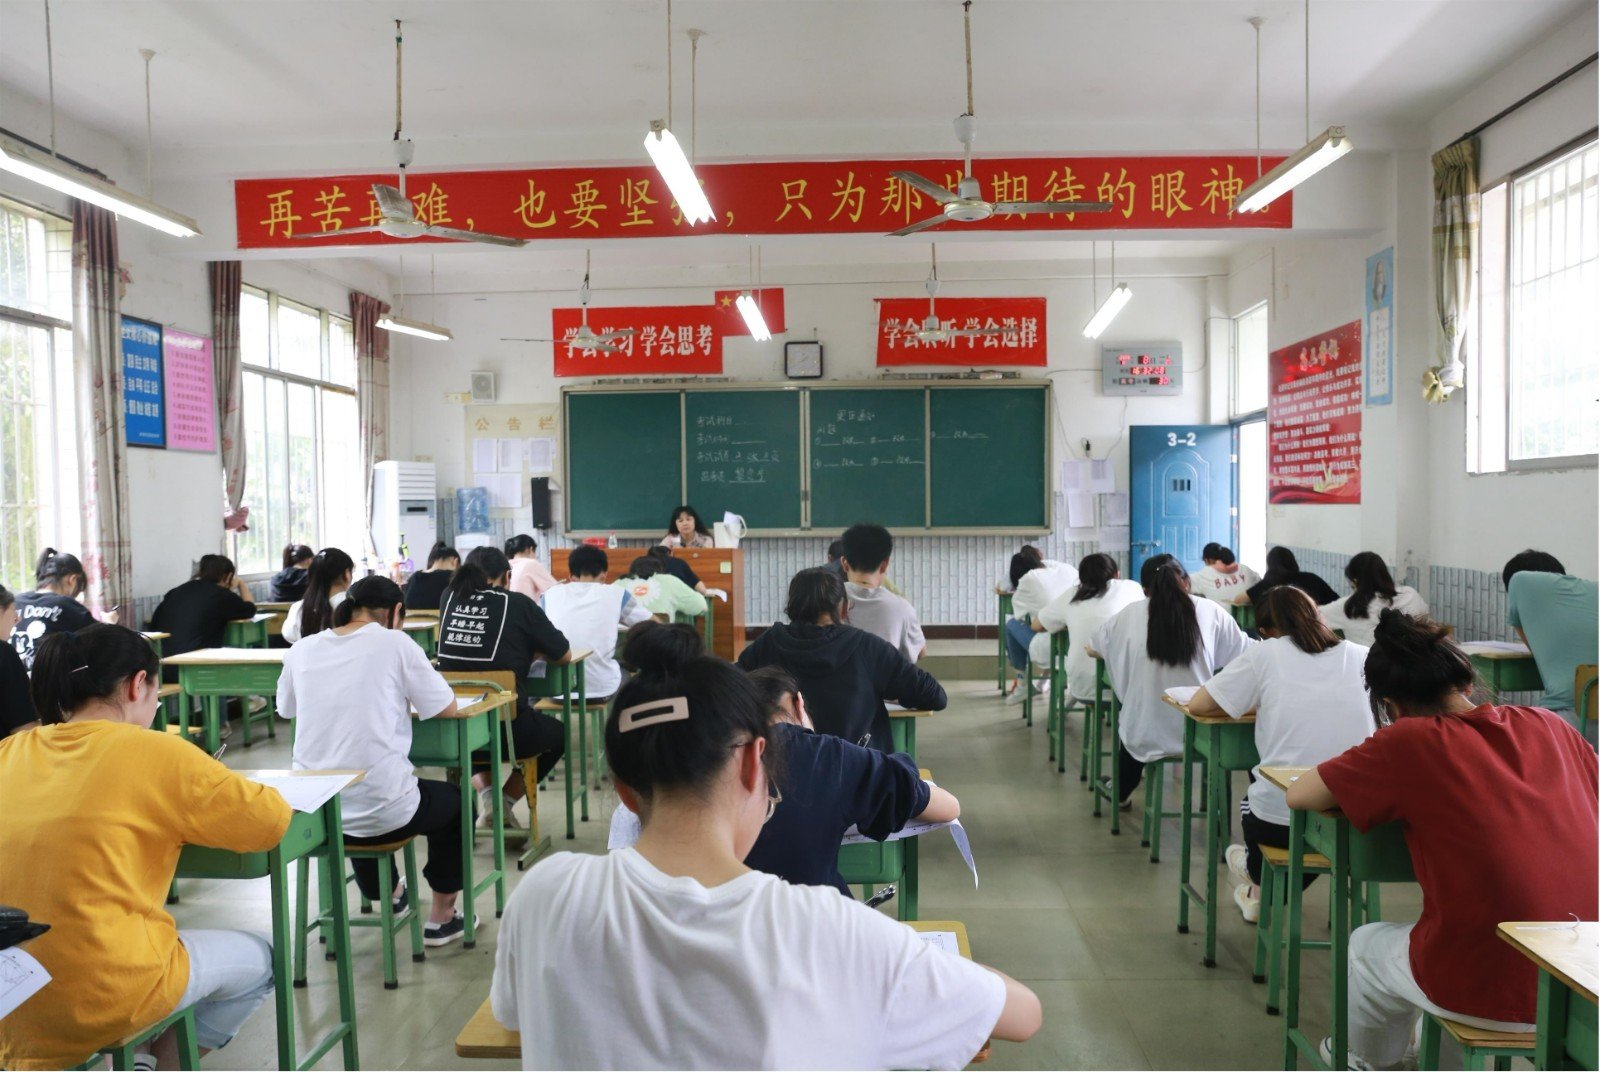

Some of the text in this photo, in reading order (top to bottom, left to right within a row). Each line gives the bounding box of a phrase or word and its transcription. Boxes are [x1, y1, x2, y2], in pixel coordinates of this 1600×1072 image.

[640, 325, 714, 357] 学会思考
[474, 415, 555, 432] 公告栏
[1167, 432, 1196, 447] 3-2
[1214, 573, 1245, 590] BABY
[455, 605, 487, 615] 认真学习
